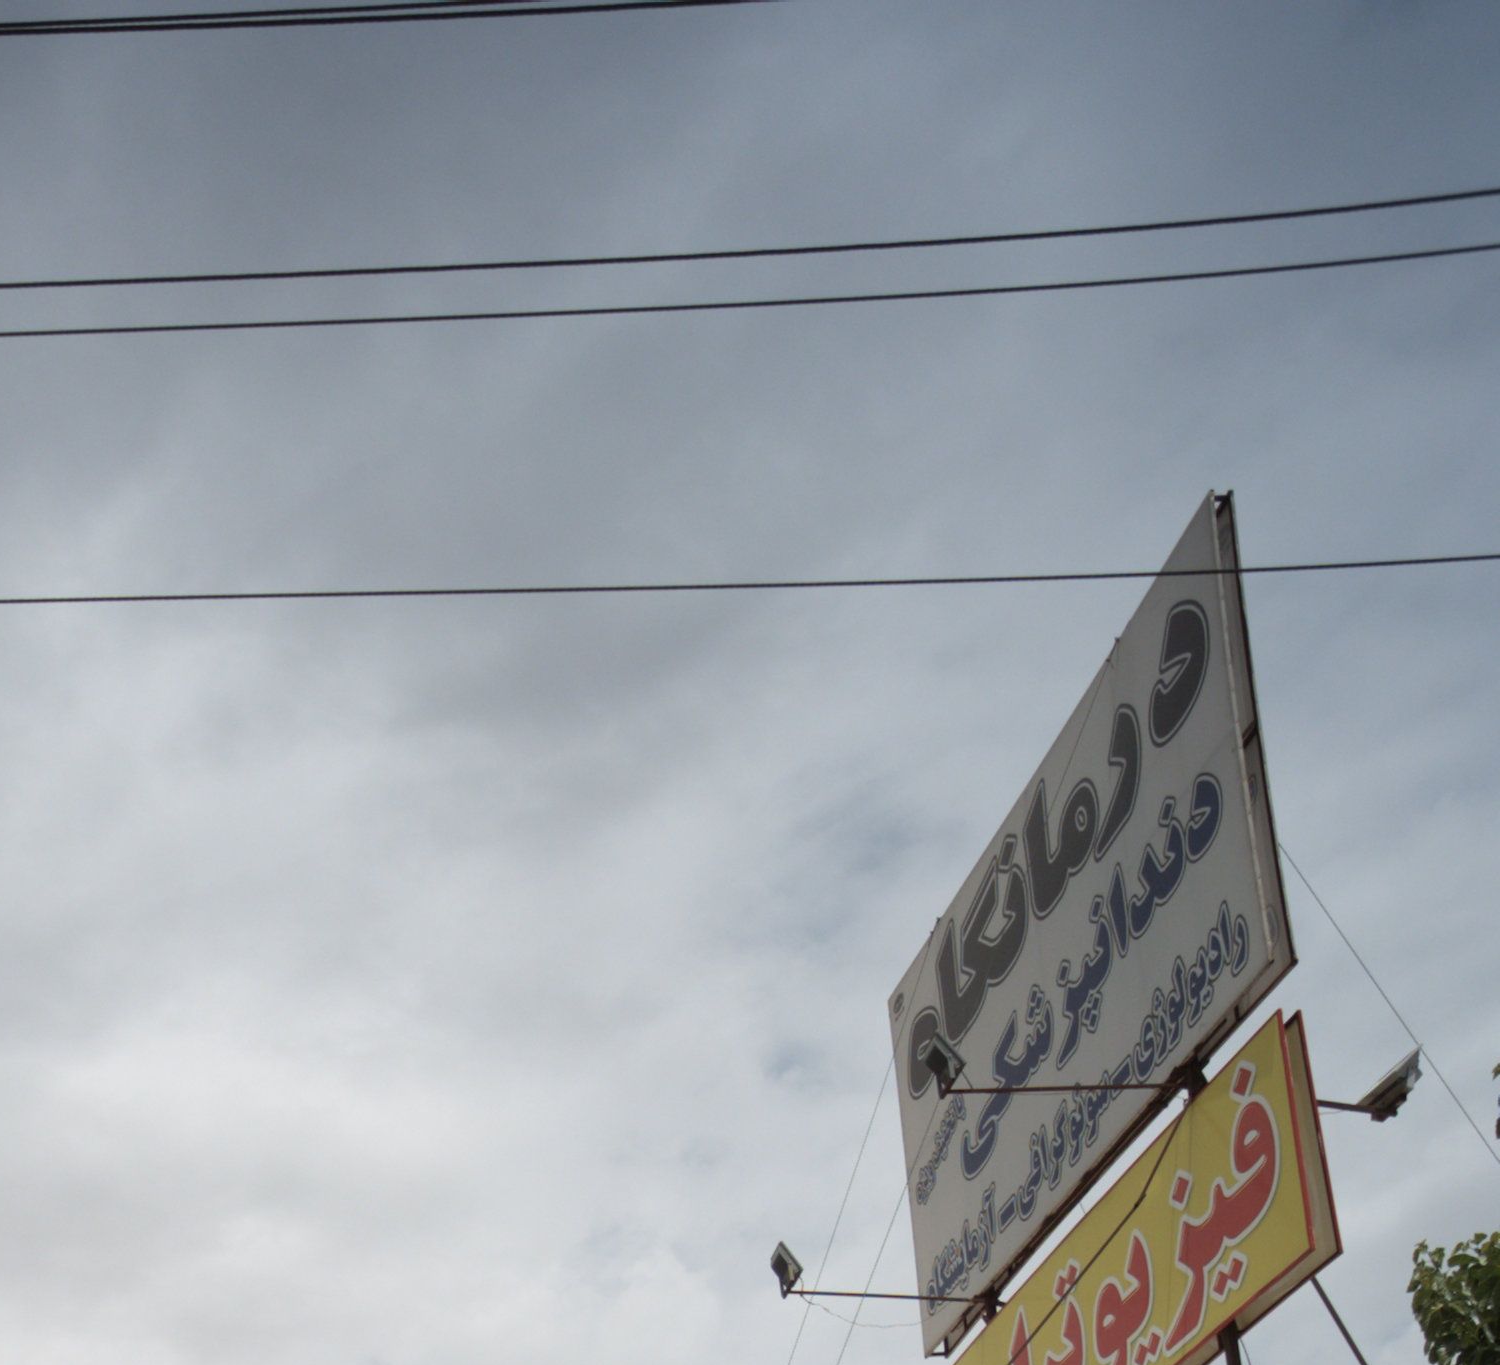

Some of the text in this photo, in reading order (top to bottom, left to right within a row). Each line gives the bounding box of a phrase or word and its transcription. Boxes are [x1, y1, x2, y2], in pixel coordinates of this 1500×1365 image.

[908, 599, 1209, 1100] درمانگاه
[960, 773, 1222, 1181] دندانپزشکی
[1133, 901, 1249, 1083] رادیولوژی
[1018, 1070, 1111, 1221] سونوگرافی
[927, 1182, 998, 1315] آزمایشگاه
